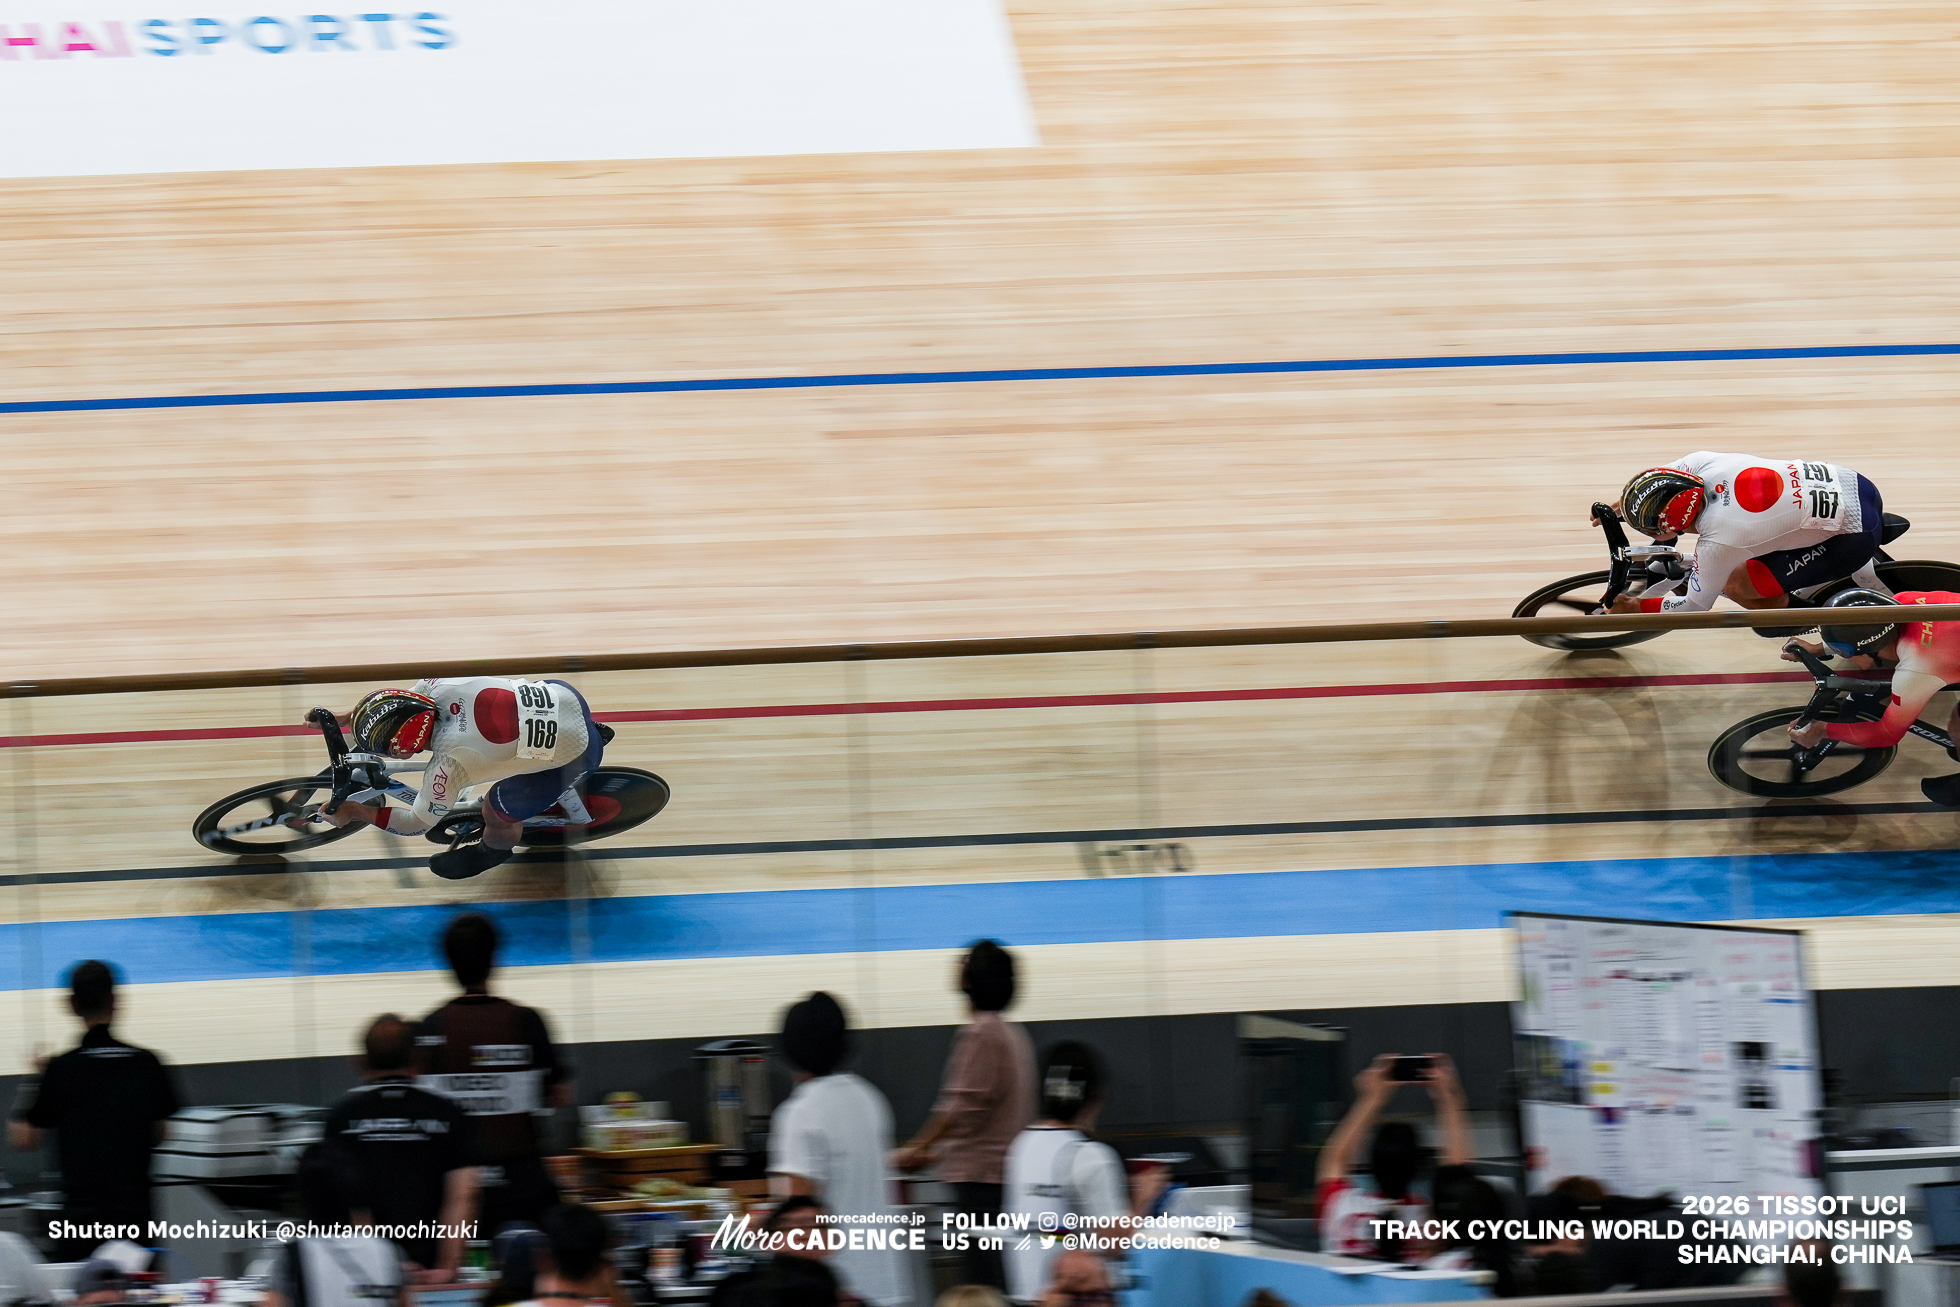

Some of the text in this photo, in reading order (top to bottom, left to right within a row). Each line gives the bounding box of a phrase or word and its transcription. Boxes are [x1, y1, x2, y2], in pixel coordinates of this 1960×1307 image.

[1682, 491, 1699, 525] JAPAN
[1809, 489, 1839, 519] 167
[1786, 545, 1827, 576] JAPAN
[1915, 597, 1933, 648] CHA
[518, 684, 555, 709] 168
[413, 714, 431, 748] JAPAN
[525, 718, 558, 749] 168
